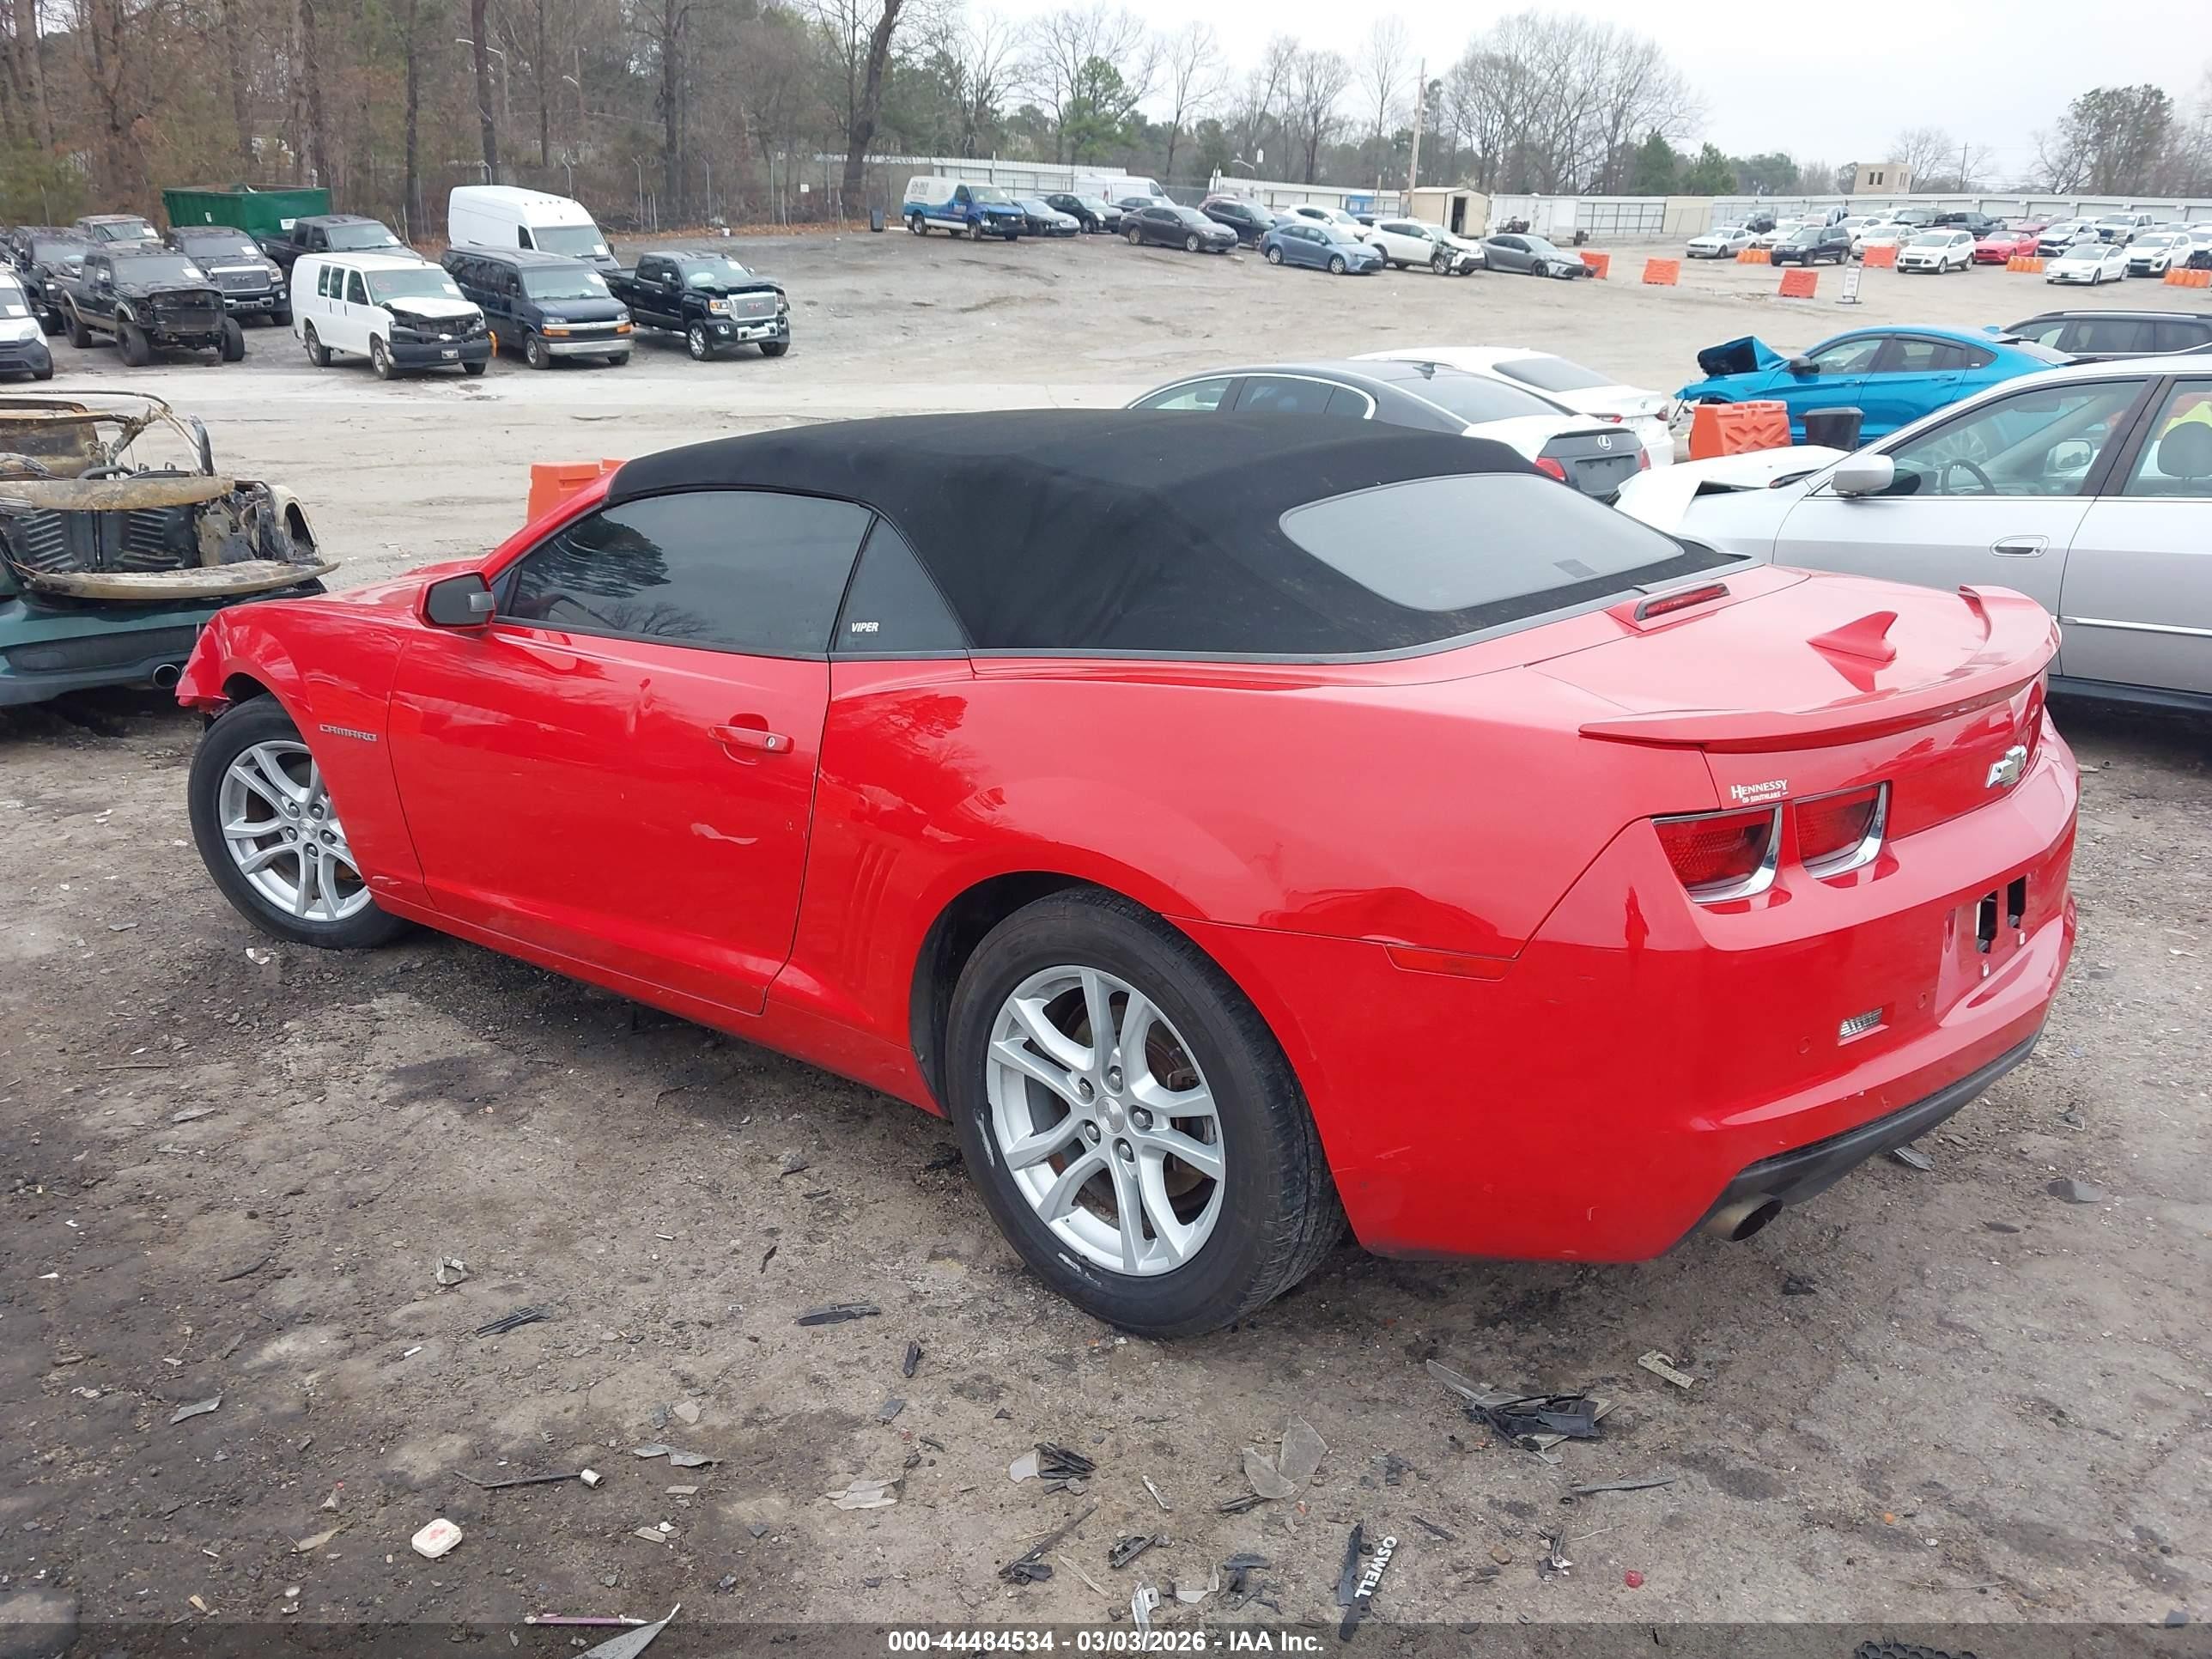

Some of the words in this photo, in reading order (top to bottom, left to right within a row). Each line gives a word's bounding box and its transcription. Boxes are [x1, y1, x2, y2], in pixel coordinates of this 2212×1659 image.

[851, 622, 879, 633] VIPER
[319, 724, 377, 742] CAMARO
[1730, 779, 1788, 799] HENNESSY
[1354, 1536, 1398, 1598] OSWELL
